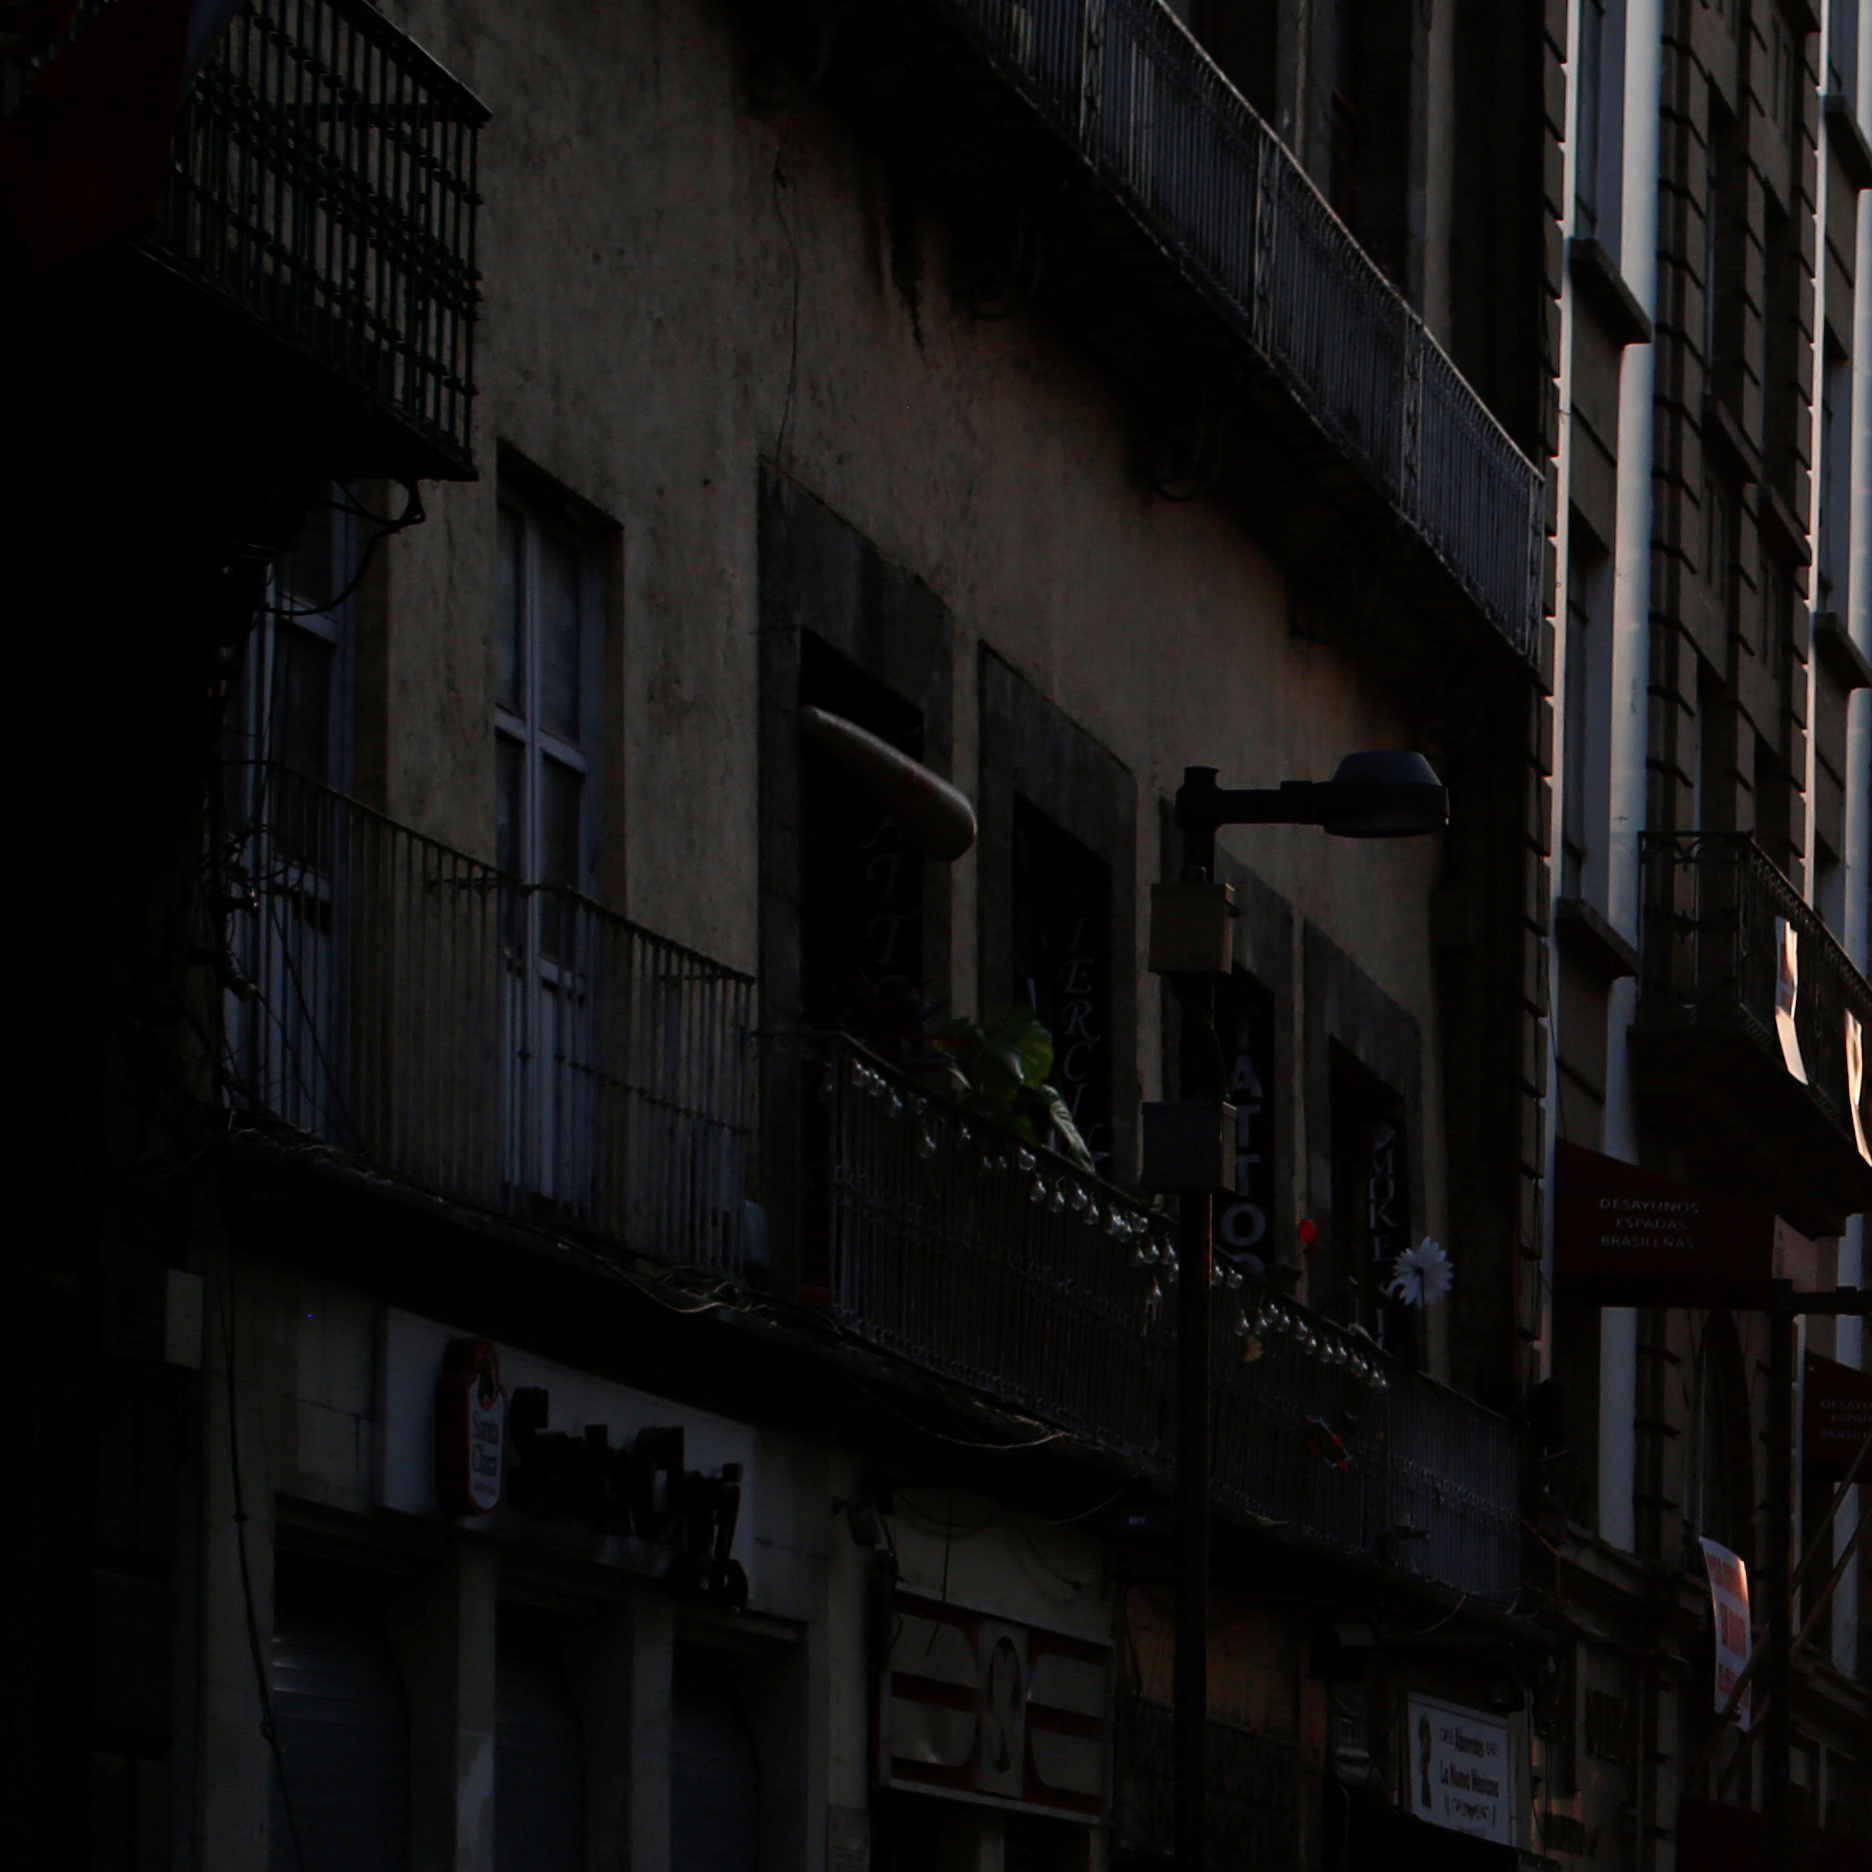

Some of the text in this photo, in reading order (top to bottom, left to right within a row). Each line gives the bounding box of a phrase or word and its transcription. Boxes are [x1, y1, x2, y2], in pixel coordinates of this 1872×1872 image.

[1599, 1197, 1700, 1214] DESAYUNOS
[1615, 1217, 1688, 1231] ESPADAS
[1600, 1234, 1695, 1249] BRASILEÑAS
